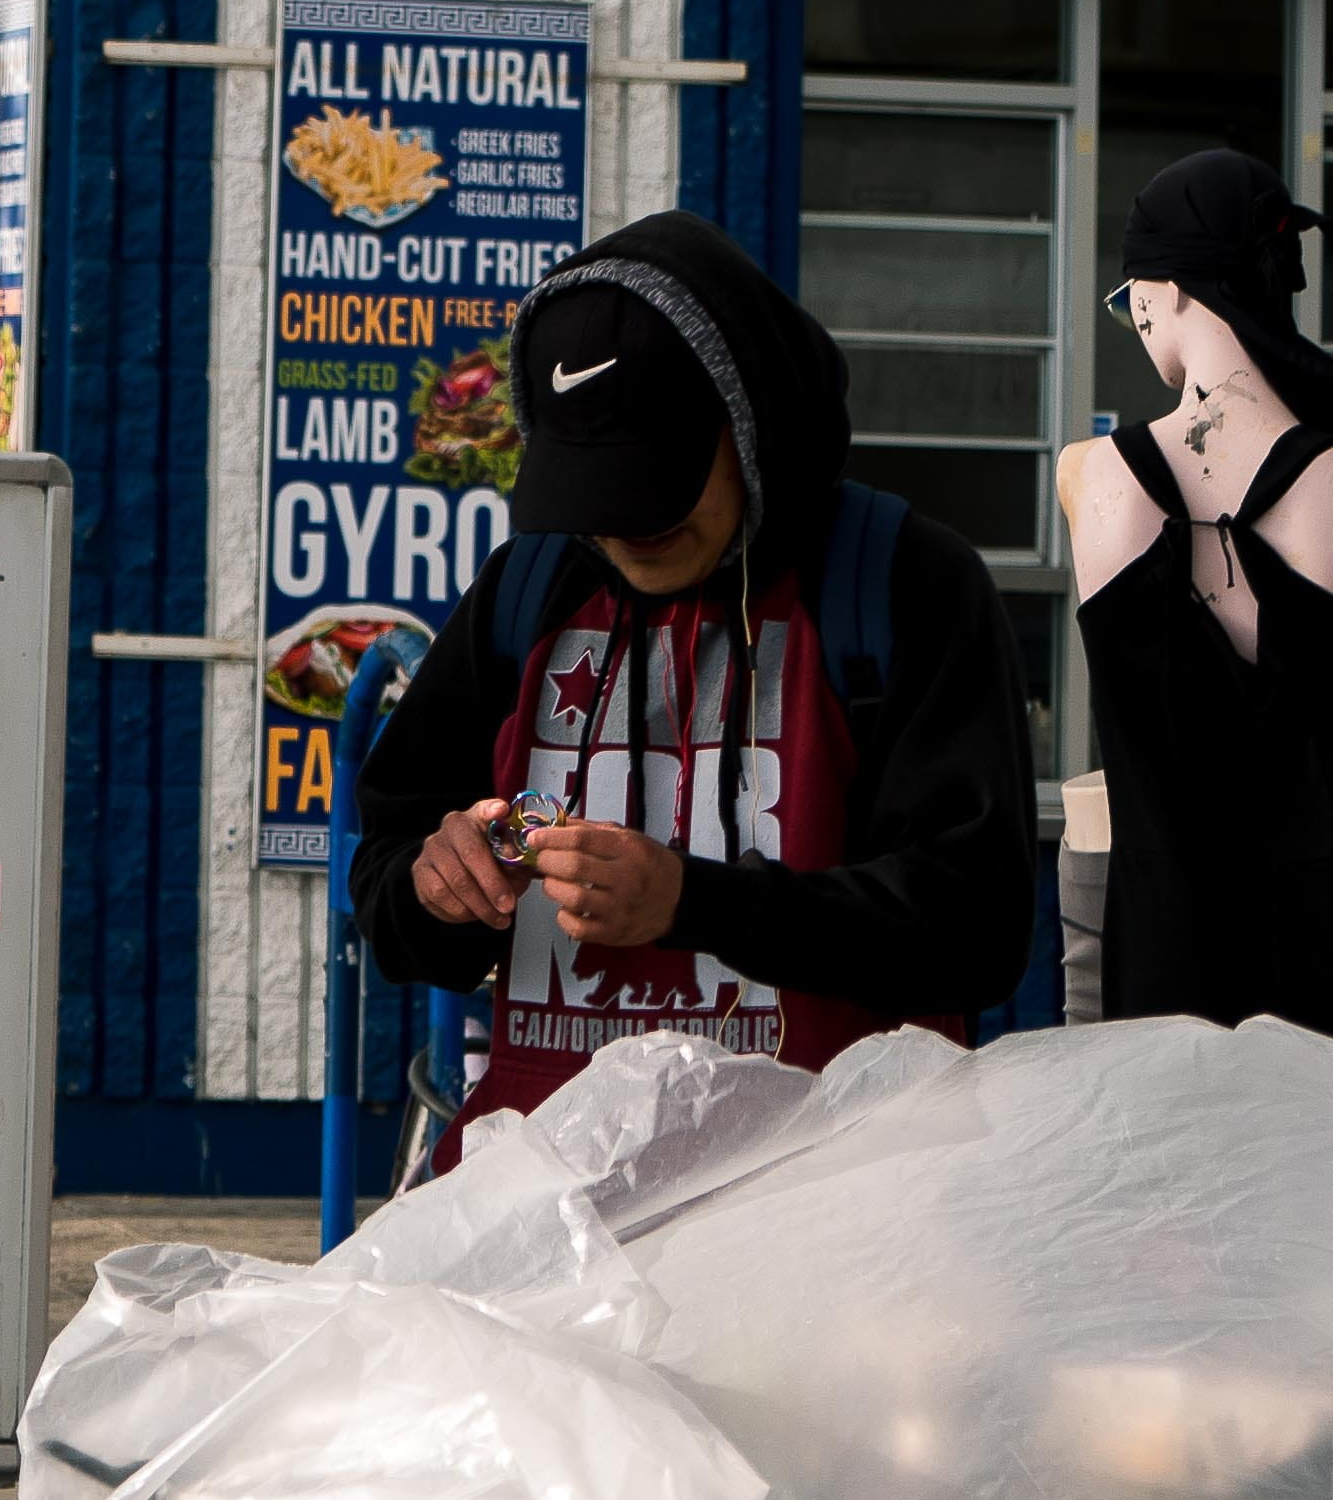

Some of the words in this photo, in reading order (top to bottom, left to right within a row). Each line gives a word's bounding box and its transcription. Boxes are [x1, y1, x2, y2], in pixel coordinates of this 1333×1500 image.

[287, 40, 369, 100] ALL
[382, 44, 581, 109] NATURAL
[458, 128, 511, 156] GREEK
[514, 130, 561, 158] FRIES
[457, 160, 515, 187] GARLIC
[517, 161, 565, 189] FRIES
[456, 191, 530, 218] REGULAR
[532, 193, 579, 221] FRIES
[282, 230, 468, 285] HAND-CUT
[281, 292, 434, 347] CHICKEN
[278, 360, 398, 392] GRASS-FED
[276, 397, 399, 463] LAMB
[272, 480, 510, 601] GYRO
